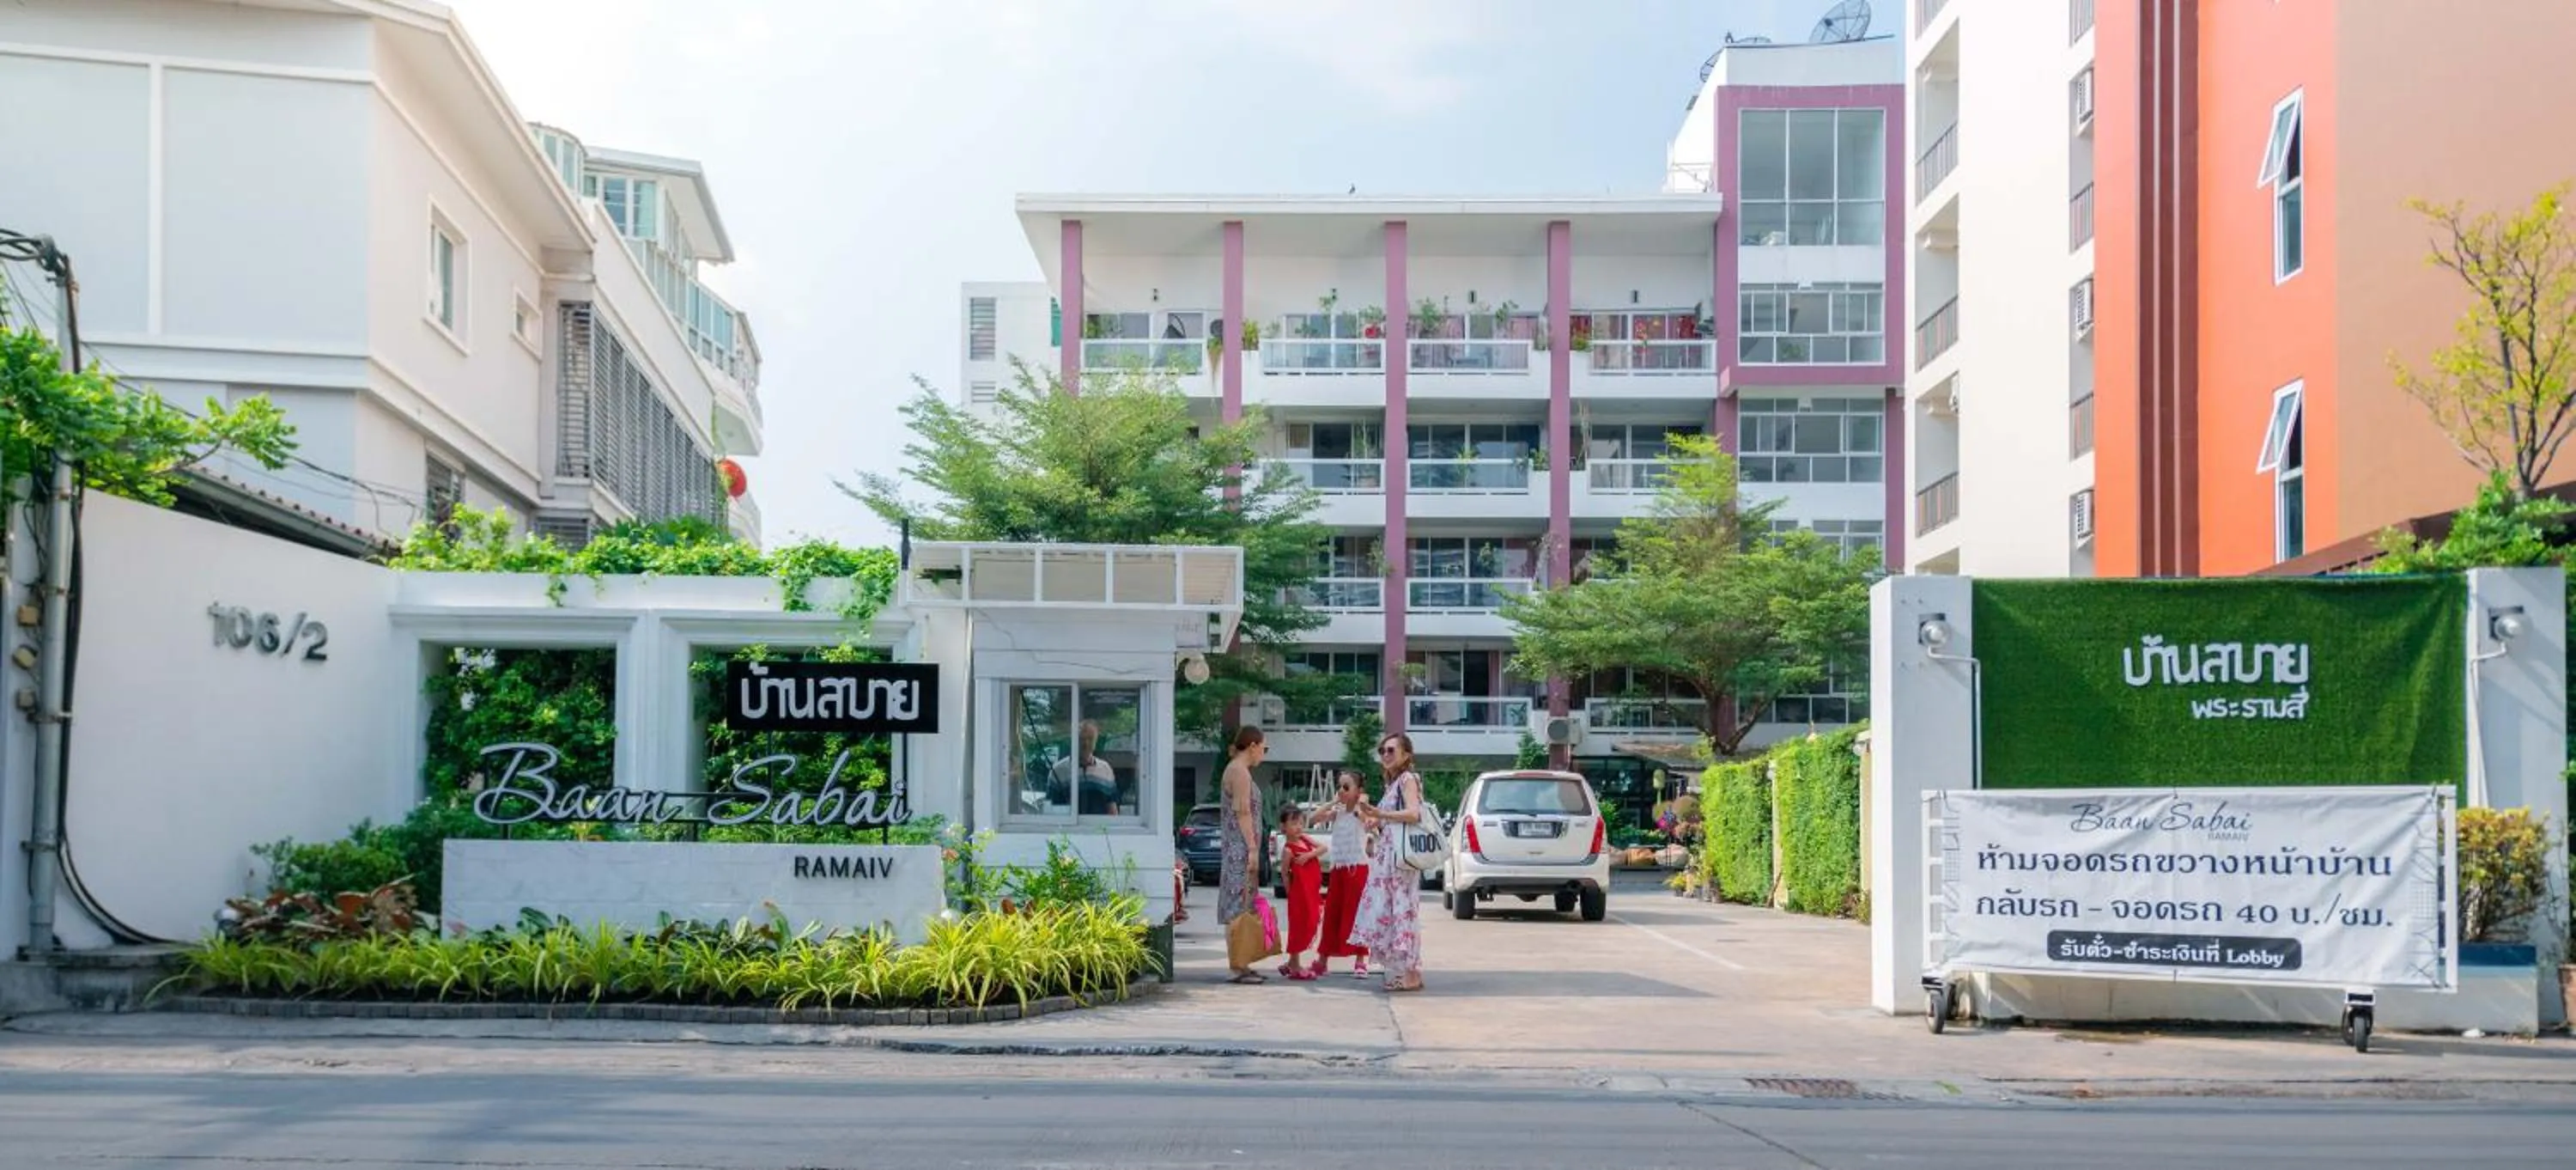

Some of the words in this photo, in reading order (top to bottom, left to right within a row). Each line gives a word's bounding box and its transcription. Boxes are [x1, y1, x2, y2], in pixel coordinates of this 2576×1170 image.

[207, 600, 328, 661] 106/2
[2123, 633, 2310, 687] บ้านสบาย
[740, 661, 920, 721] บ้านสบาย
[2190, 686, 2310, 720] พระรามสี่
[473, 741, 684, 825] Baan
[707, 747, 913, 826] Sabai
[2070, 802, 2154, 833] Baan
[2159, 801, 2252, 832] Sabai
[793, 856, 894, 880] RAMAIV
[1977, 842, 2391, 877] ห้ามจอดรถขวางหน้าบ้าน
[1976, 887, 2080, 918] กลับรถ
[2110, 899, 2223, 922] จอดรถ
[2235, 903, 2279, 924] 40
[2226, 948, 2286, 969] Lobby
